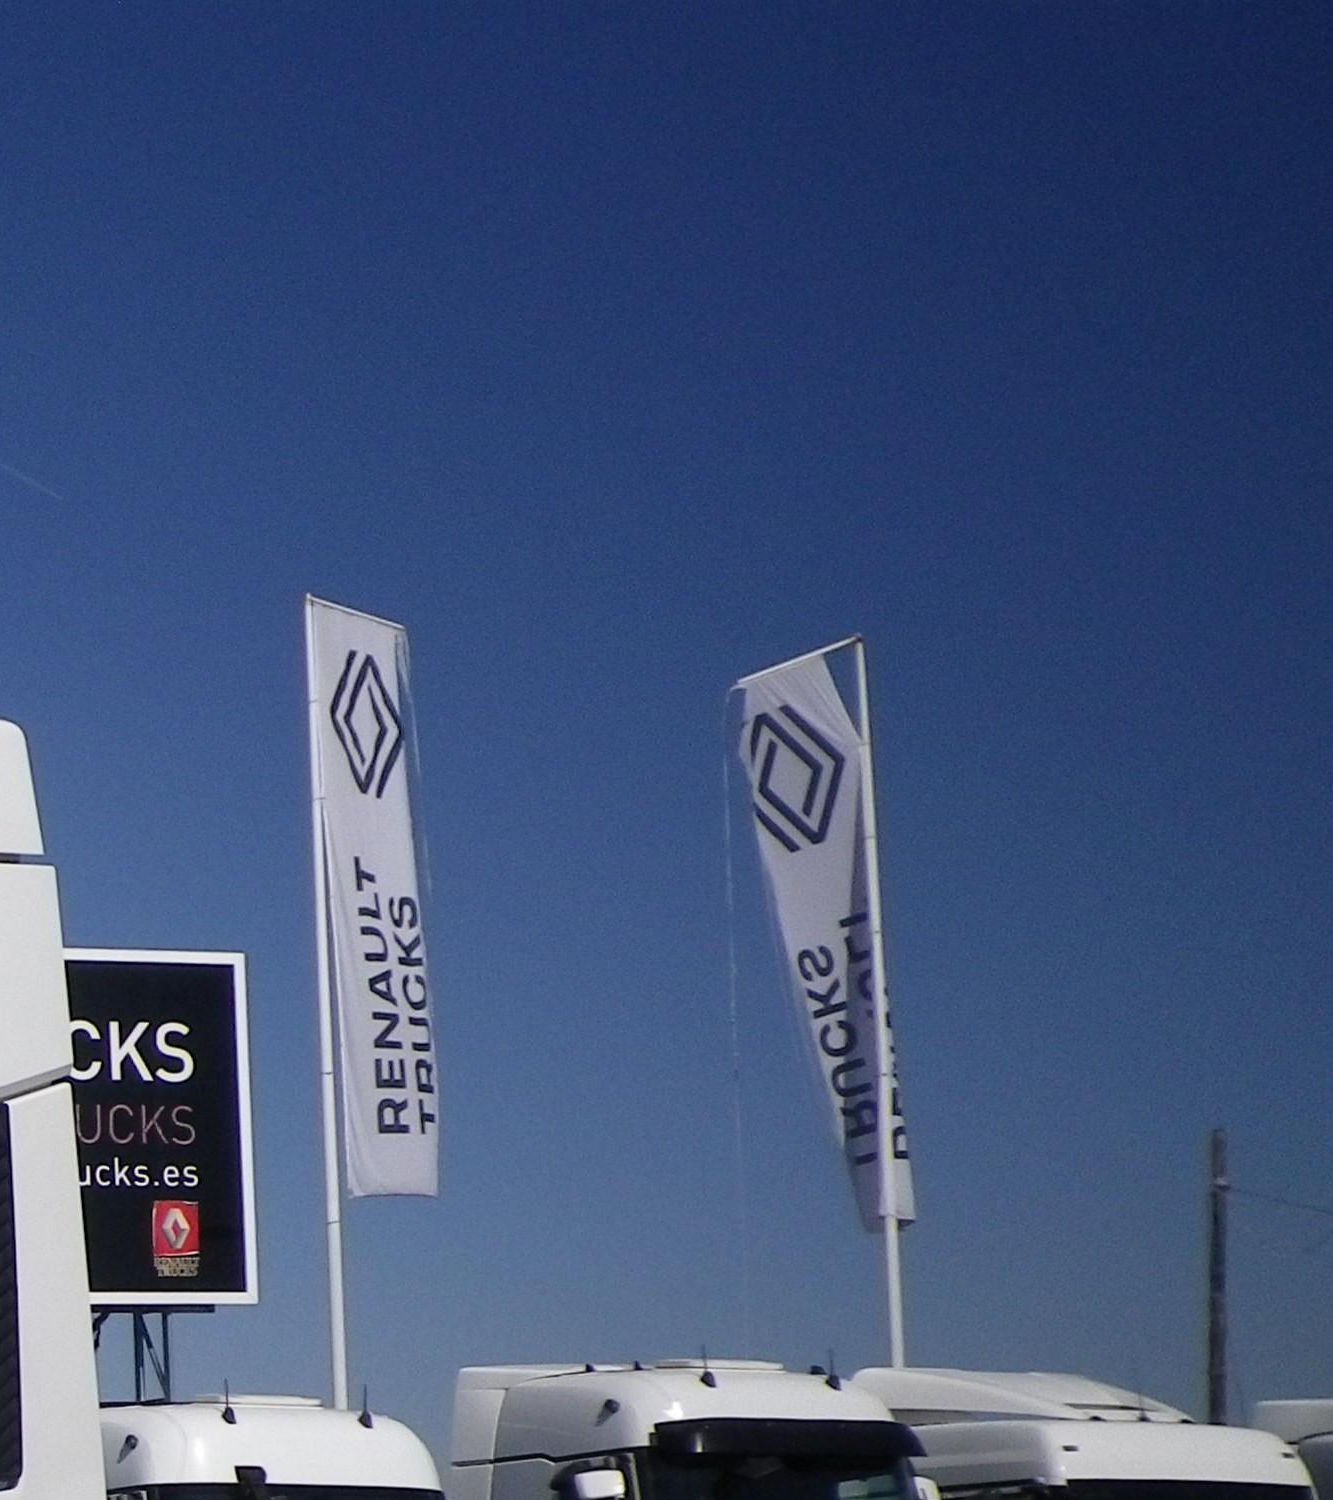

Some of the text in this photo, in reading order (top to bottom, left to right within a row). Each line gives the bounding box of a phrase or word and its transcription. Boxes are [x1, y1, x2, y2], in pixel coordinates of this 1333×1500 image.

[70, 1020, 195, 1083] CKS
[354, 856, 410, 1134] RENAULT
[389, 896, 435, 1135] TRUCKS
[75, 1103, 196, 1145] UCKS
